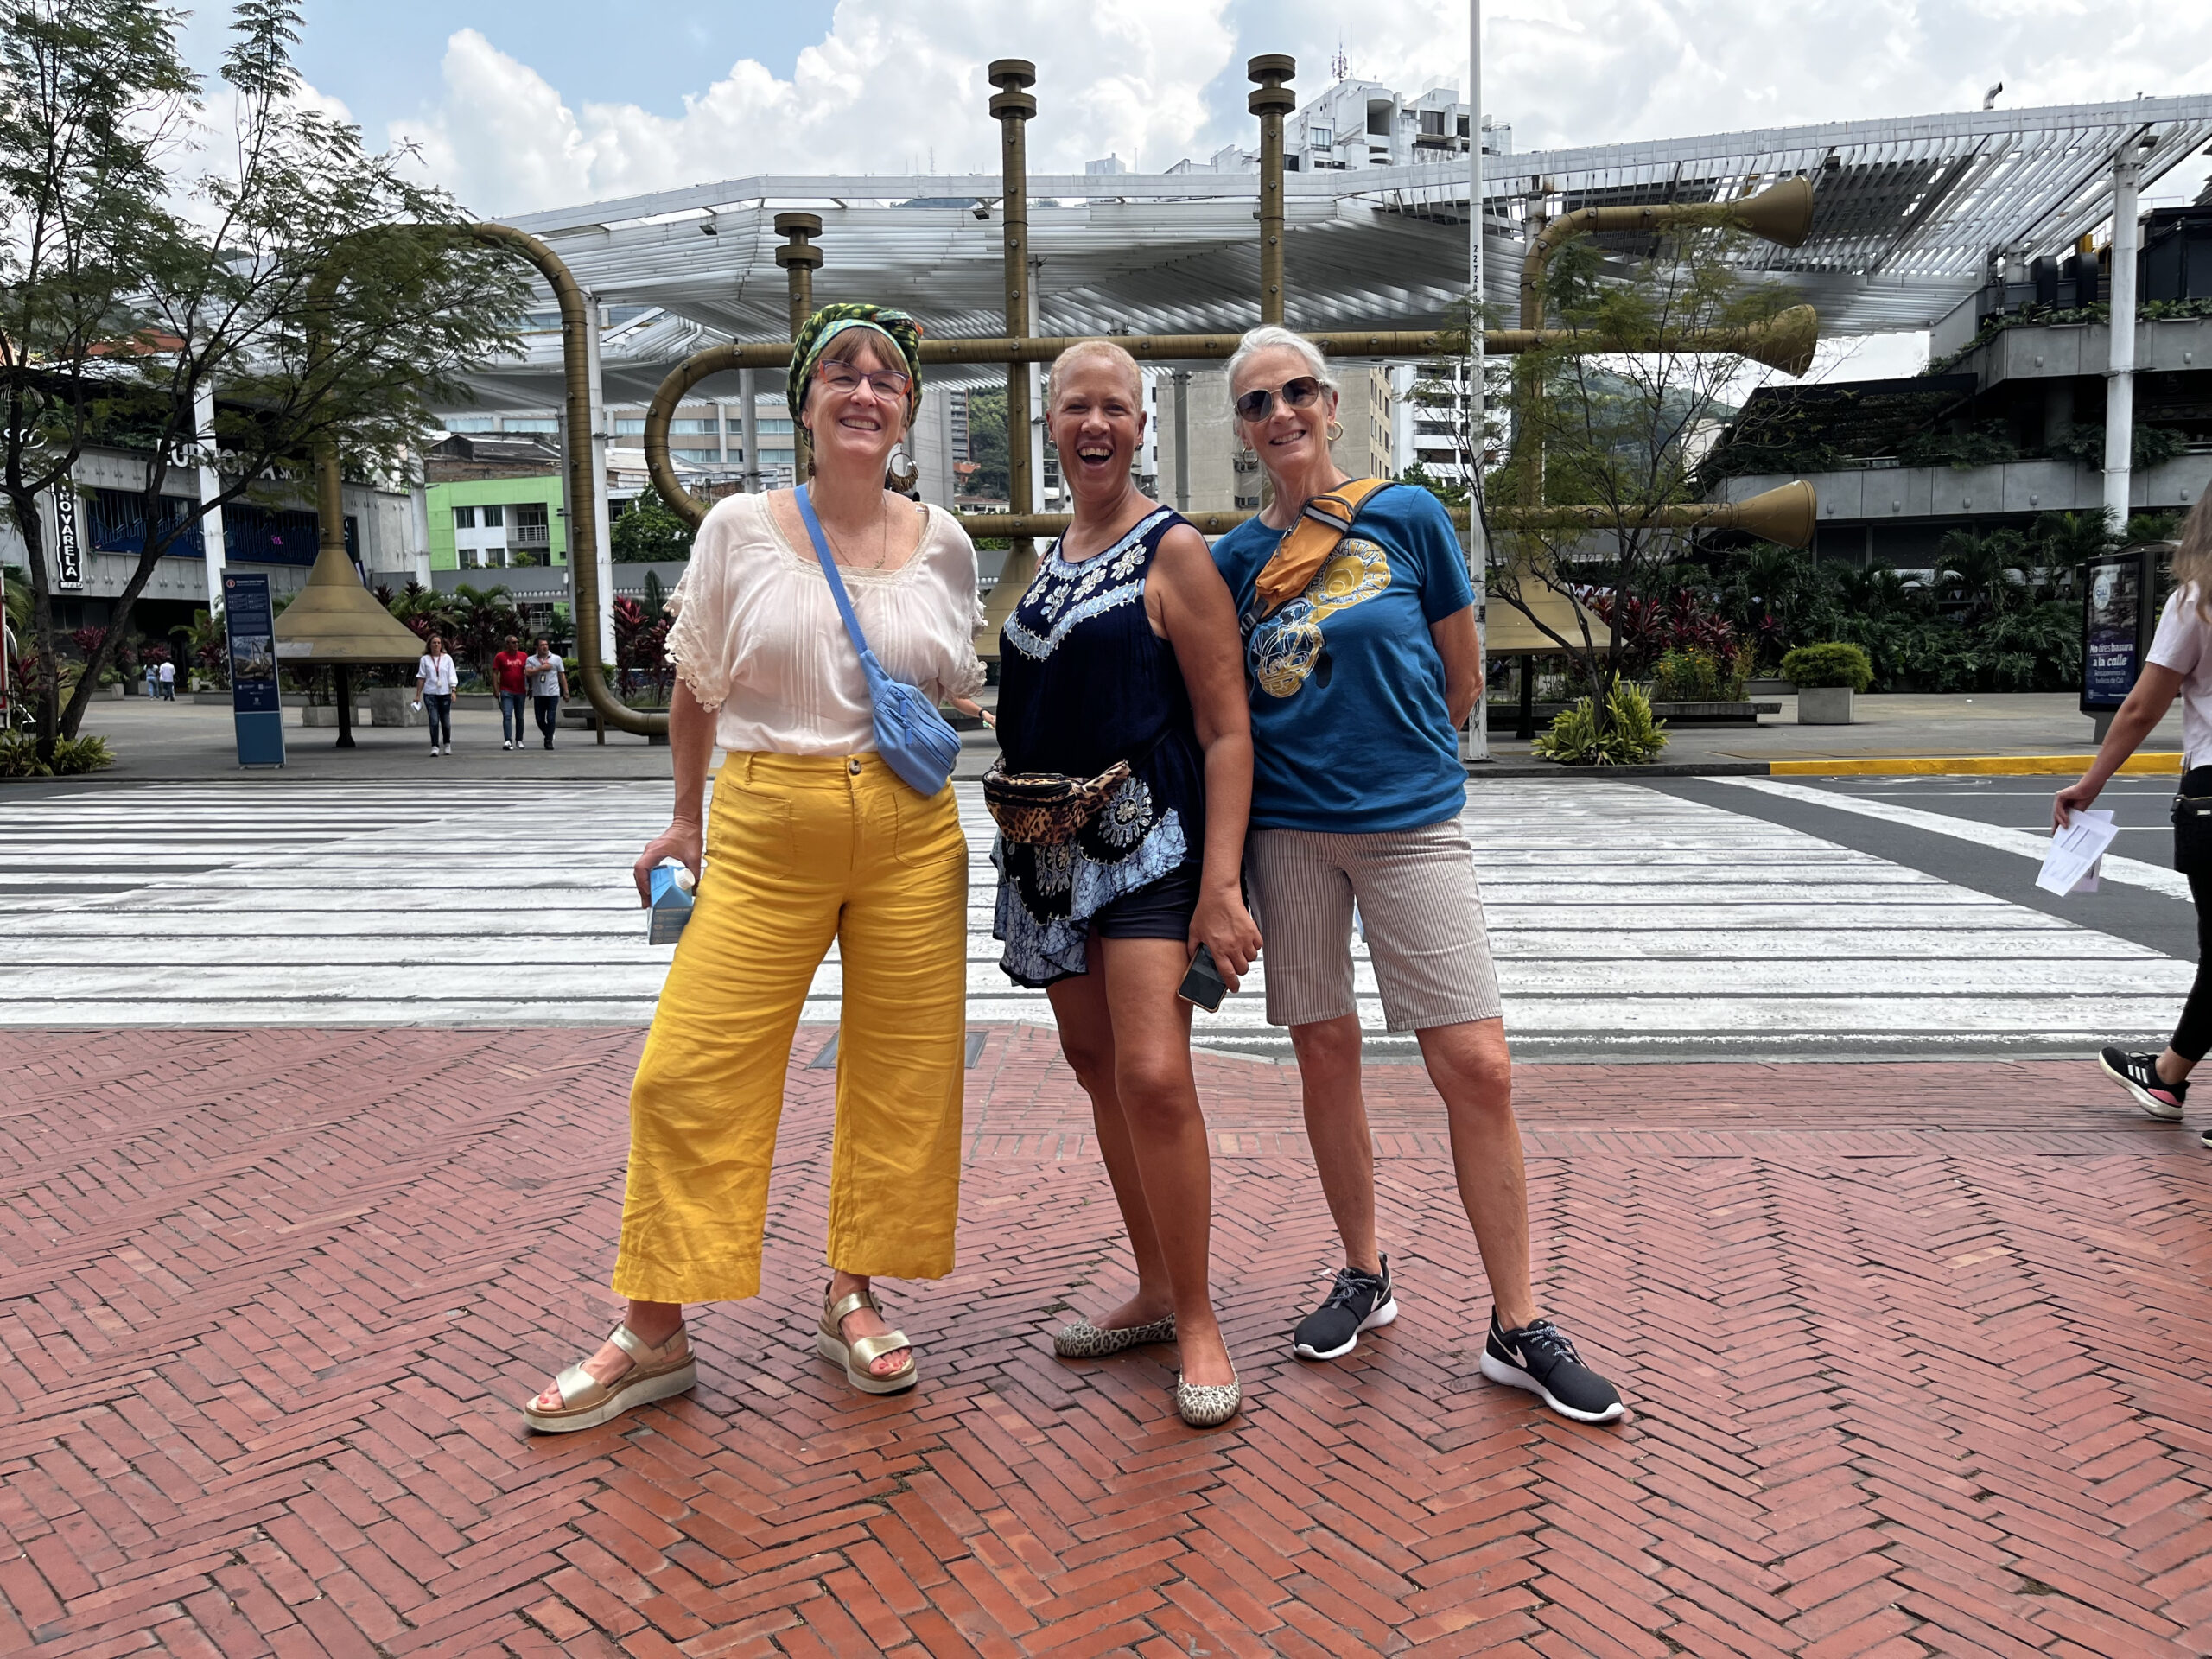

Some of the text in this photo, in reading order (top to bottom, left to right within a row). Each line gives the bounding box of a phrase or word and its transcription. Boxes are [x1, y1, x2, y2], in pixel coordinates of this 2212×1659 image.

[2111, 642, 2133, 652] basura
[2093, 654, 2127, 667] a la calle
